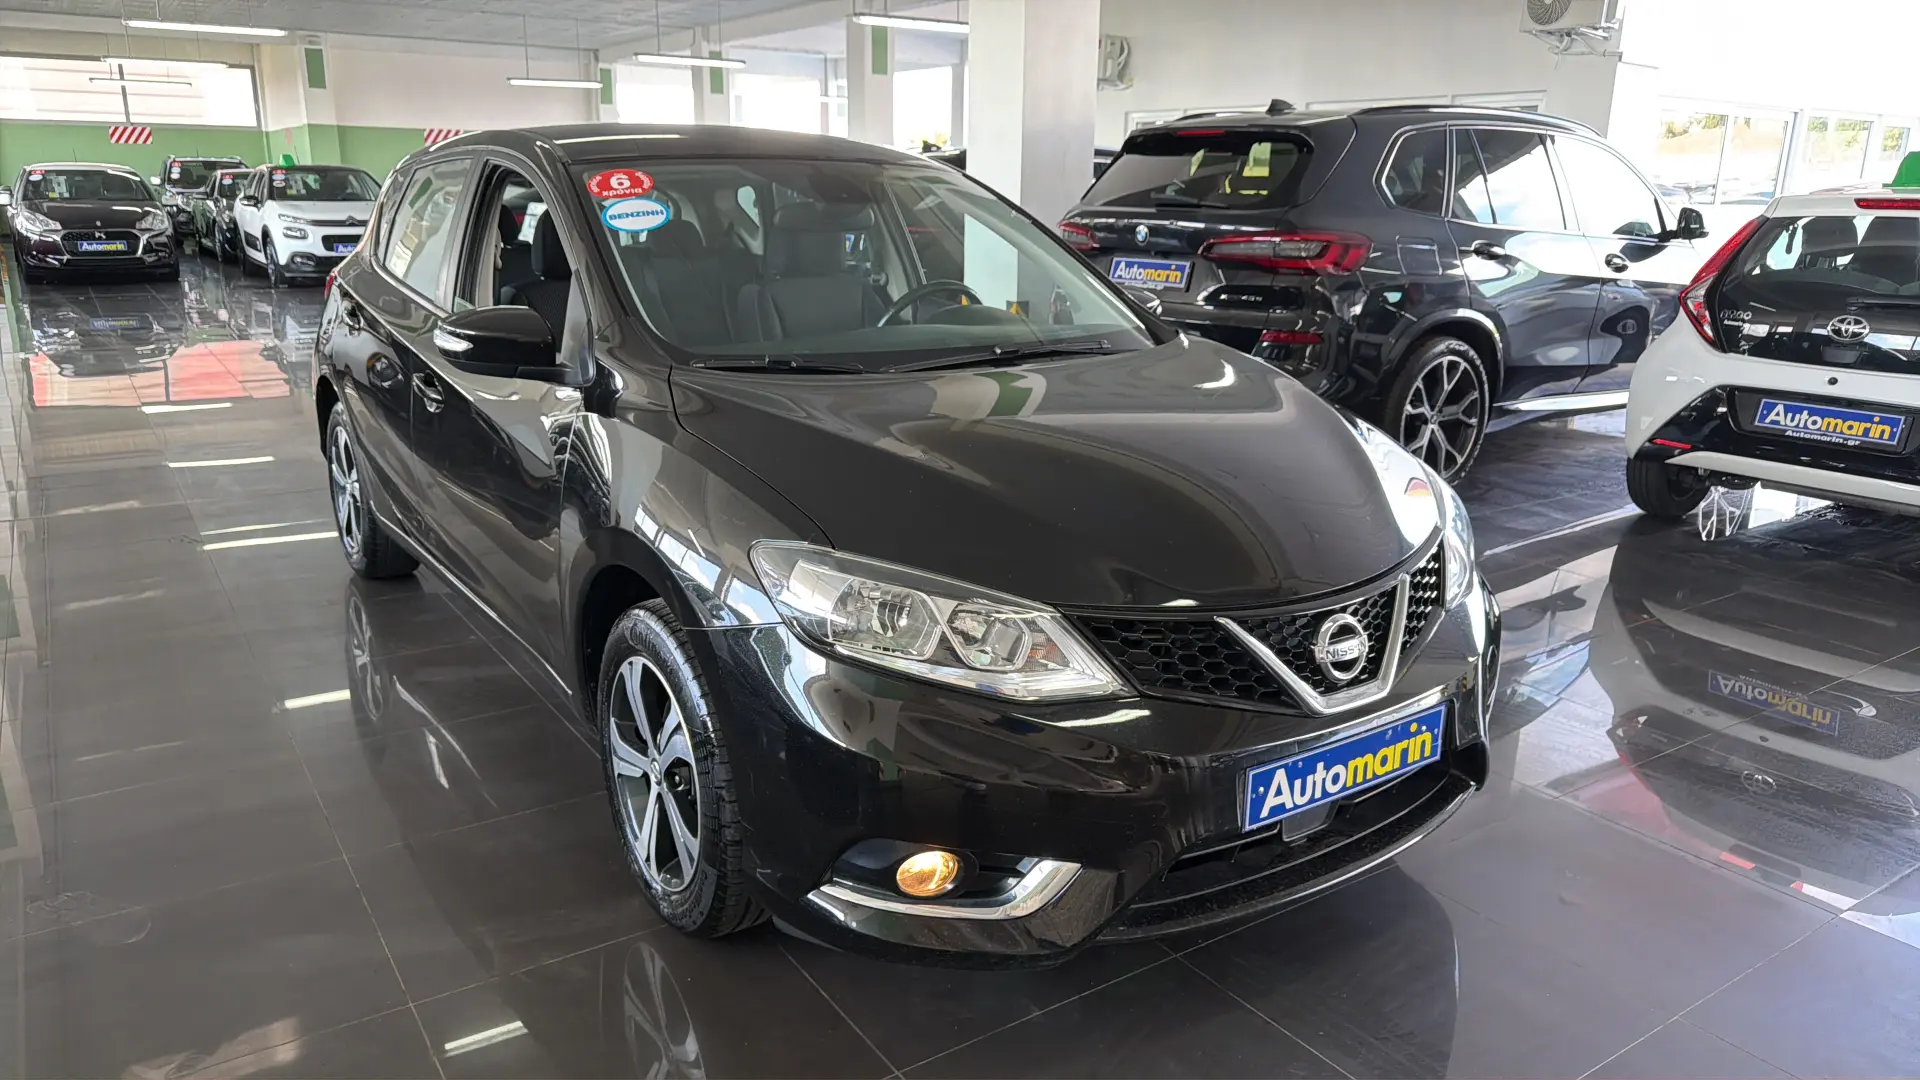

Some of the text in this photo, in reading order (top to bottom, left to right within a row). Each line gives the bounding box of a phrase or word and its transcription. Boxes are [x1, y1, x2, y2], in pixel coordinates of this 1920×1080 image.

[610, 174, 631, 188] 6
[602, 187, 643, 196] χρόνια
[82, 241, 124, 251] Automarin
[1114, 261, 1182, 283] Automarin
[1764, 403, 1892, 440] Automarin
[1784, 430, 1861, 446] Automarin.gr
[1259, 722, 1433, 819] Automarin
